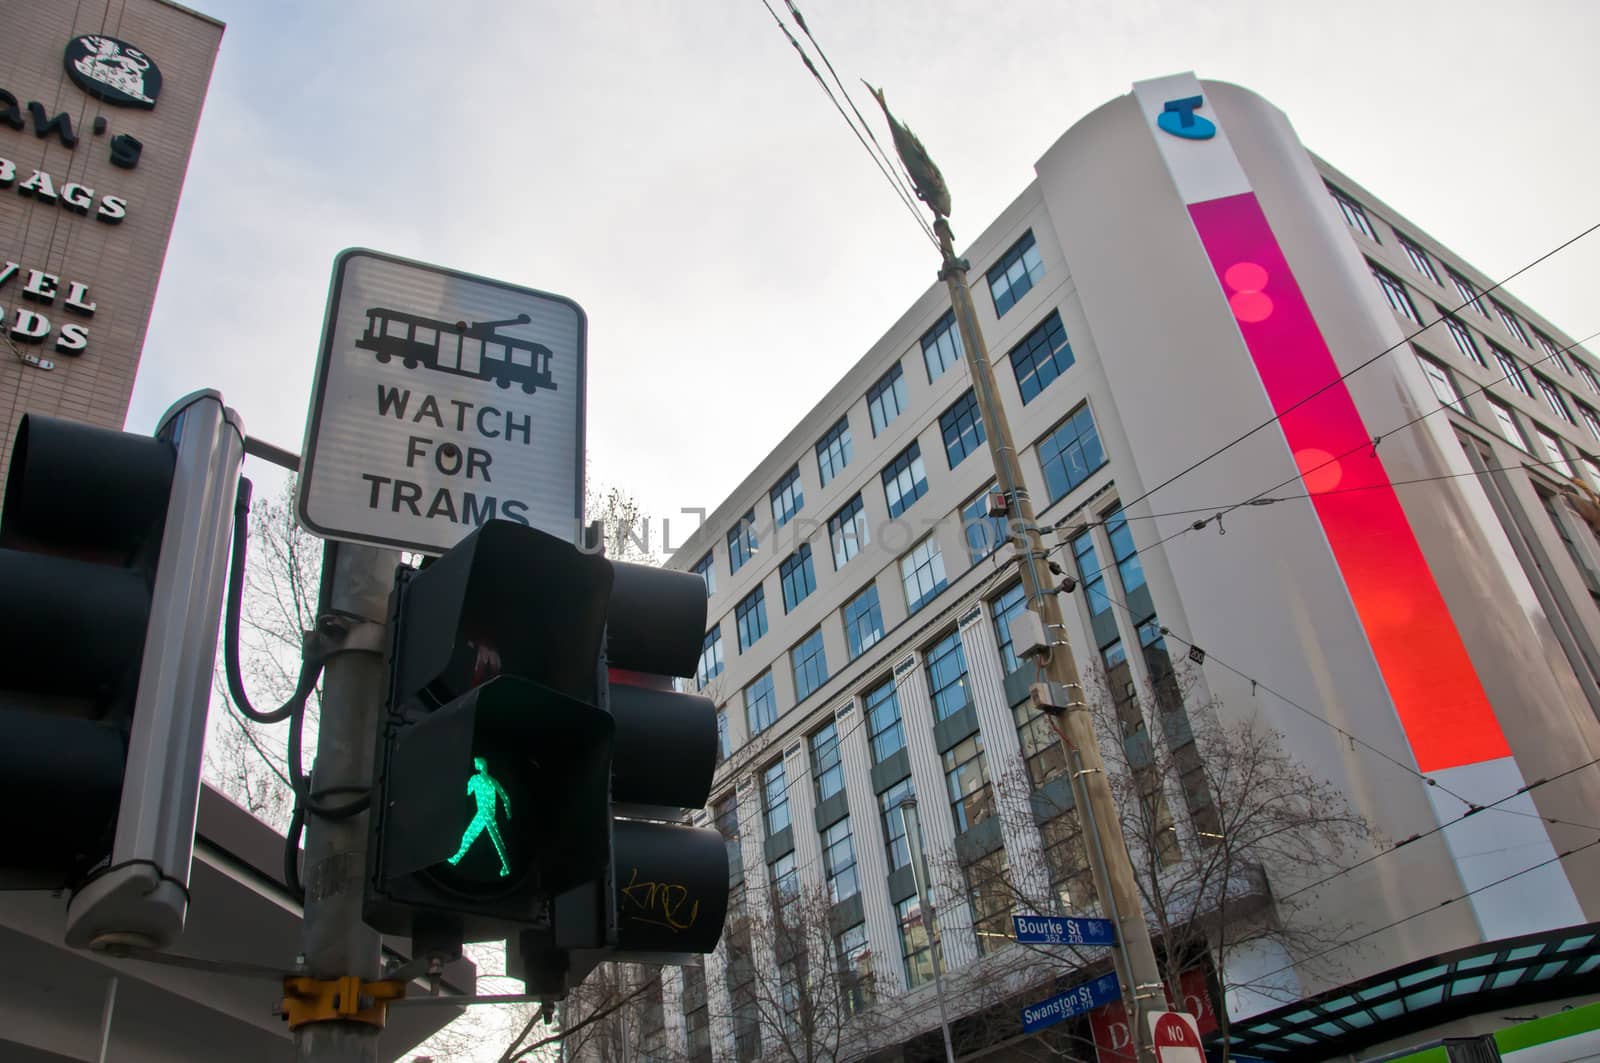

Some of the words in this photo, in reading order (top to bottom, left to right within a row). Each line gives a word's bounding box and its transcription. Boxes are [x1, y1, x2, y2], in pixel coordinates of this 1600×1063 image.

[377, 384, 532, 445] WATCH
[406, 435, 492, 482] FOR
[362, 473, 530, 527] TRAMS
[1018, 918, 1063, 935] Bourke
[1067, 919, 1081, 935] St
[1024, 994, 1078, 1024] Swanston
[1078, 986, 1092, 1002] St
[1167, 1025, 1184, 1042] NO
